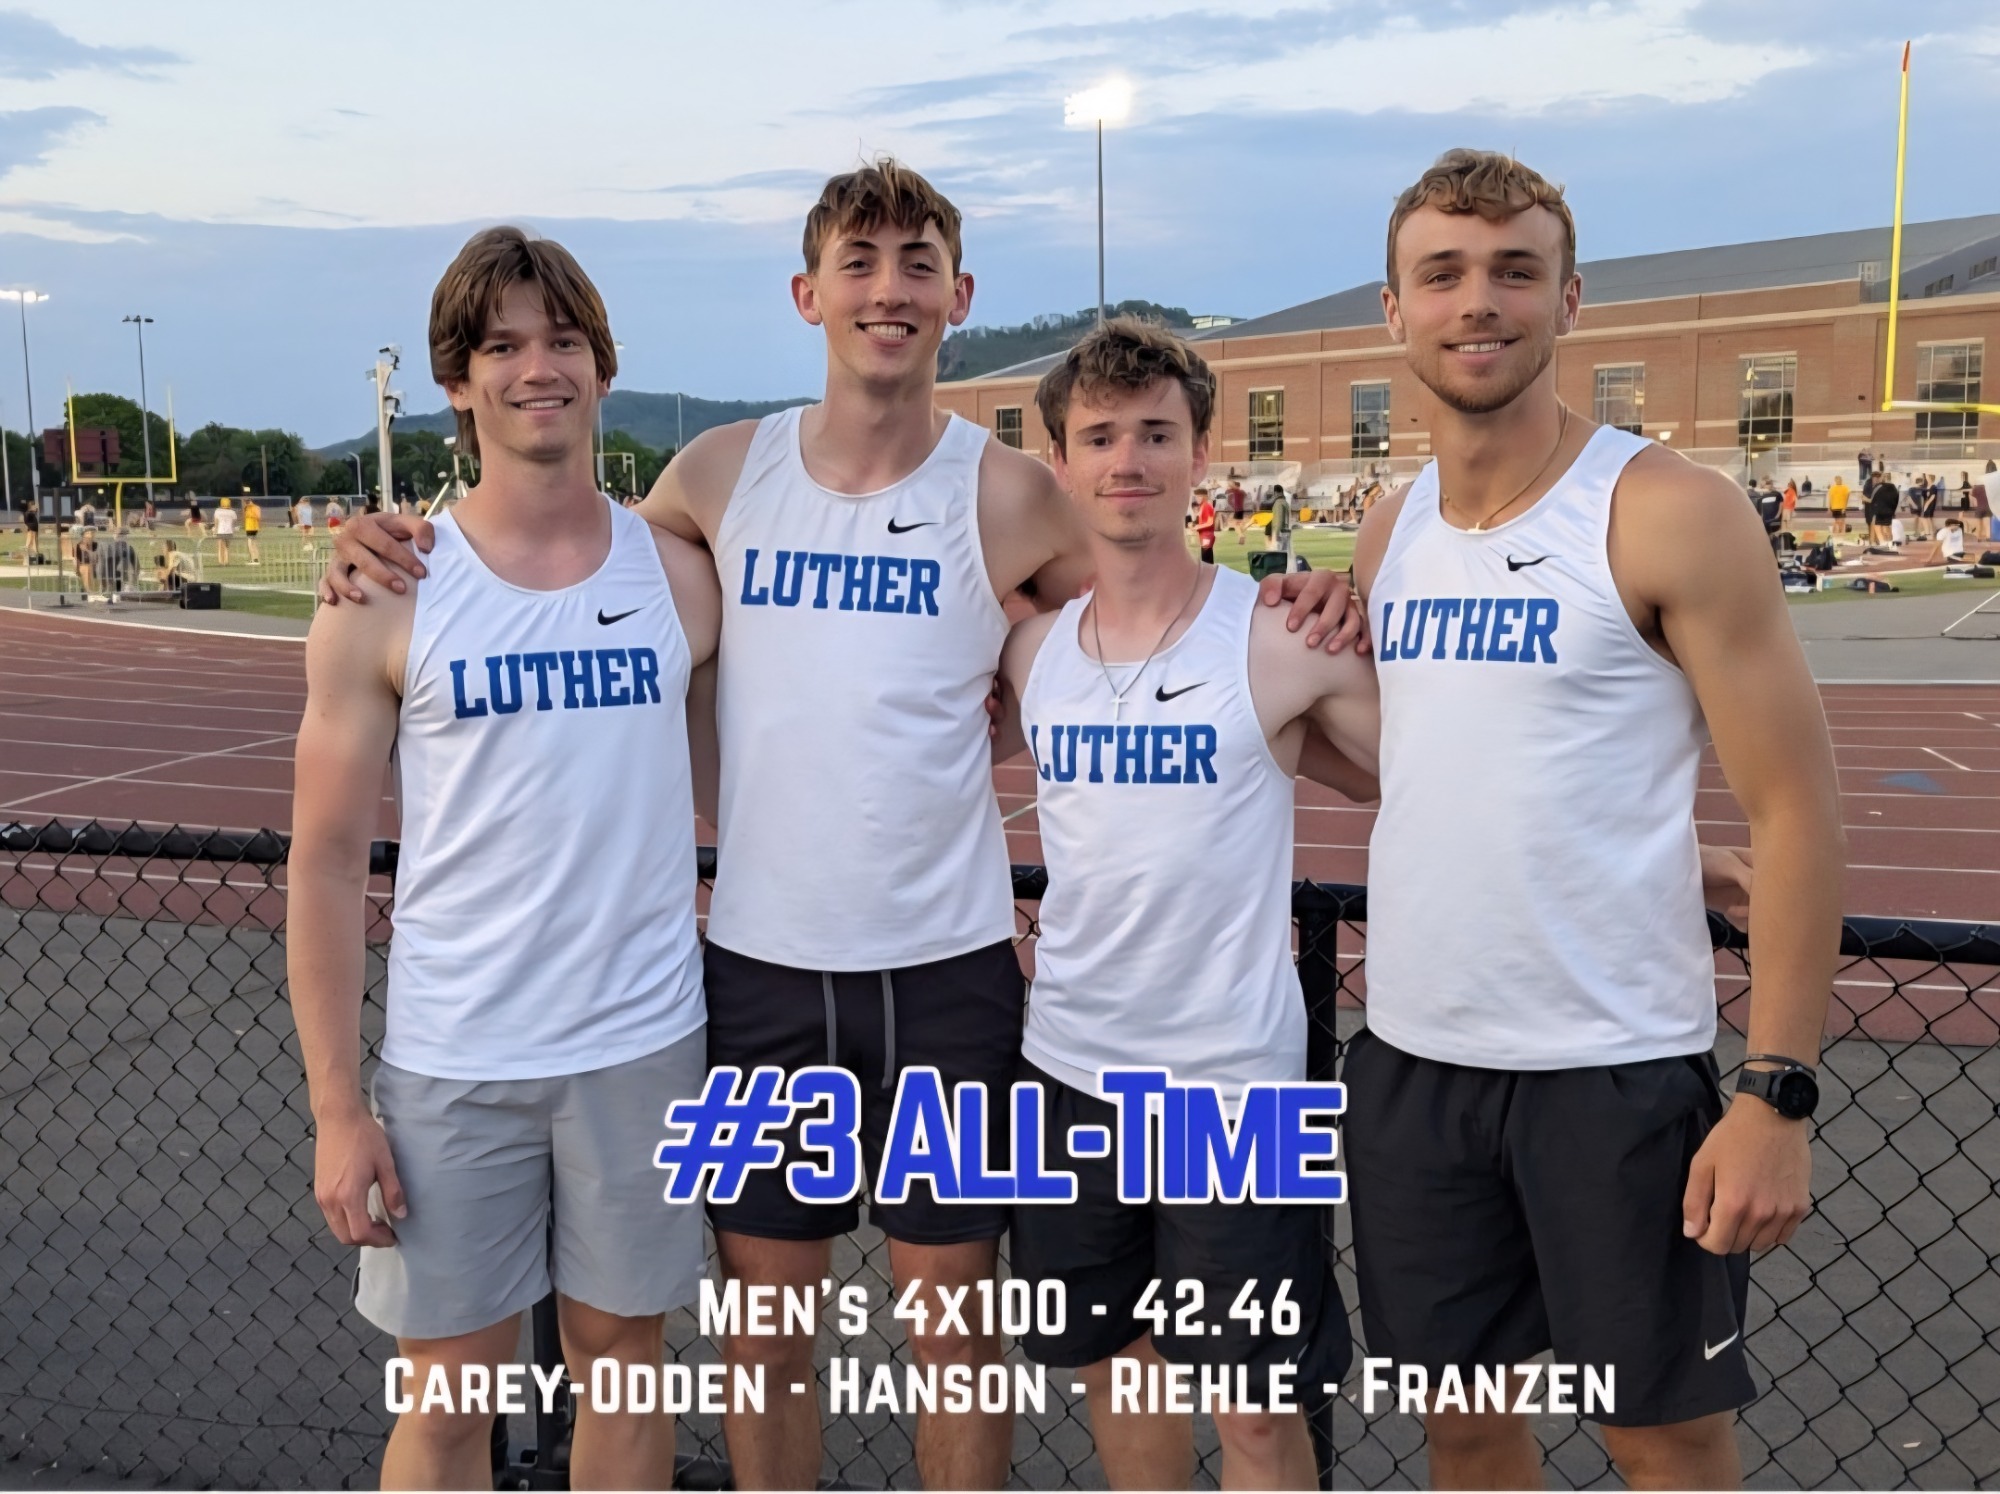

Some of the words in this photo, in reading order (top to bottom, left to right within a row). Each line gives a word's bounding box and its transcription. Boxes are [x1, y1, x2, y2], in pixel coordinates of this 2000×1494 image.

[740, 548, 941, 617] LUTHER
[1380, 598, 1559, 664] LUTHER
[449, 647, 661, 720] LUTHER
[1031, 724, 1218, 784] LUTHER
